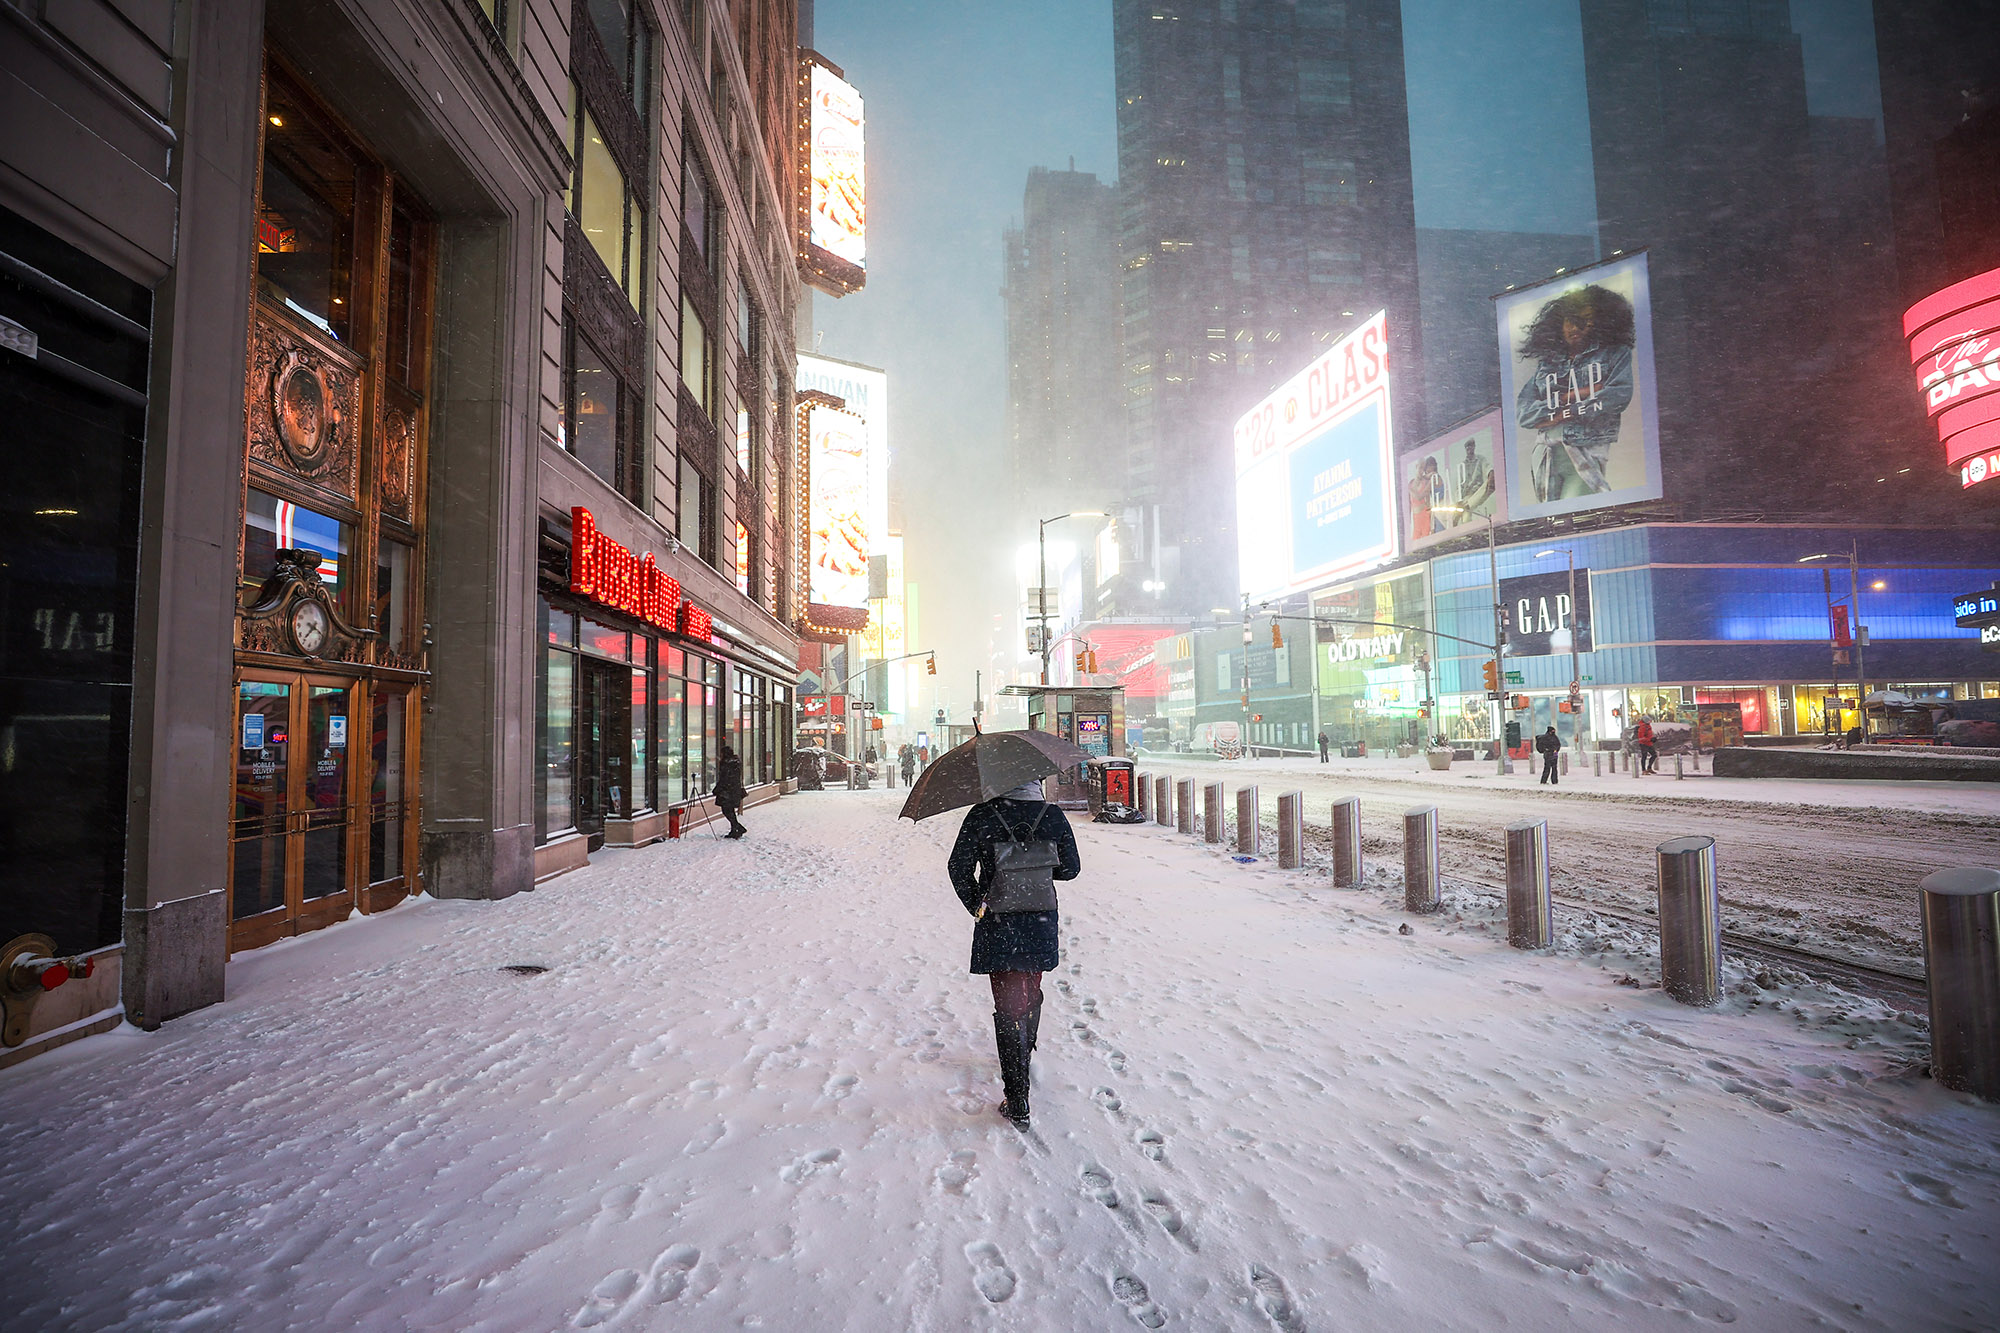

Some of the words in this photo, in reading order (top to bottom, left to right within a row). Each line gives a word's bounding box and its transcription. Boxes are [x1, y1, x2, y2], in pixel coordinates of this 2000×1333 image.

[260, 219, 279, 249] EXIT
[1931, 329, 1990, 371] The
[1545, 362, 1602, 411] GAP
[1547, 401, 1603, 421] TEEN
[1313, 459, 1353, 495] AYANNA
[1306, 476, 1363, 521] PATTERSON
[1518, 593, 1571, 635] GAP
[1954, 600, 1977, 618] side
[1980, 597, 1997, 613] in
[1328, 638, 1357, 663] OLD
[1359, 632, 1404, 660] NAVY
